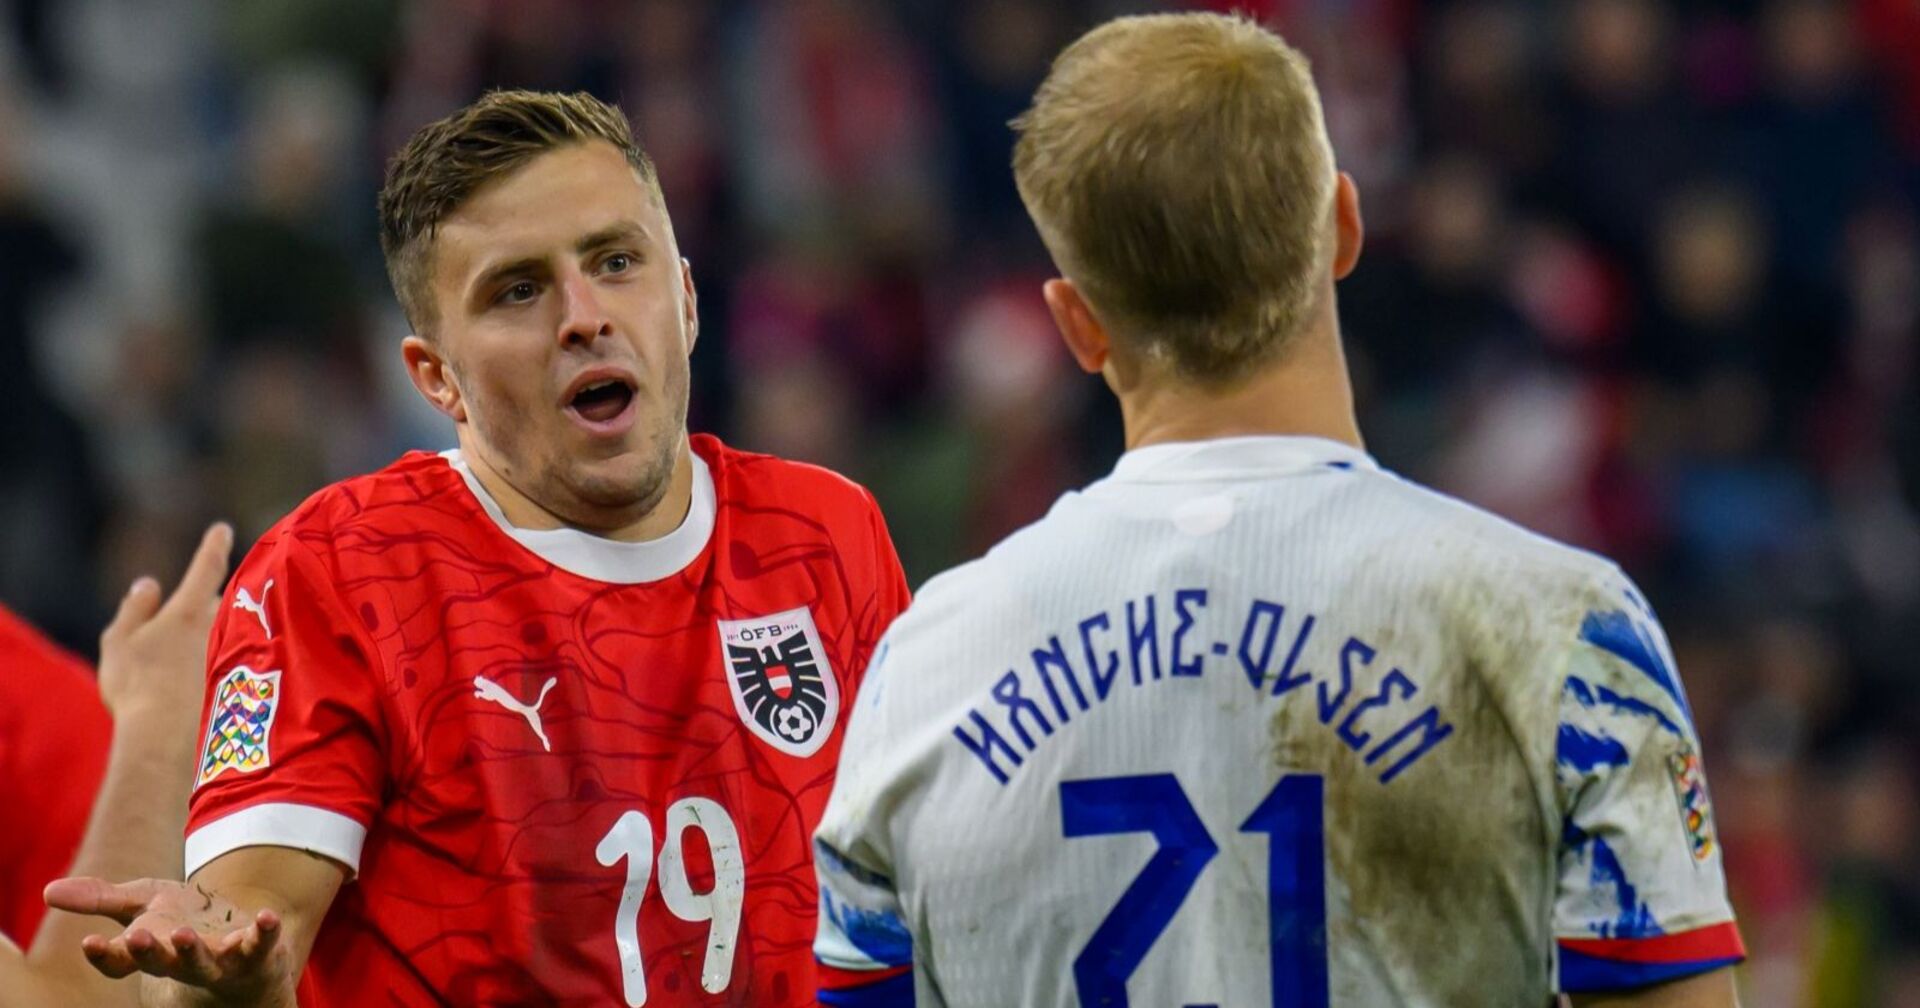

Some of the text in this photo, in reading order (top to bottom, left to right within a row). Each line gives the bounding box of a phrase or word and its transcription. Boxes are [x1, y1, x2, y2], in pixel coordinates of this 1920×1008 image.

[741, 625, 782, 641] ÖFB
[953, 589, 1454, 785] HANCHE-OLSEN
[595, 797, 745, 1008] 19
[1059, 773, 1331, 1008] 21
